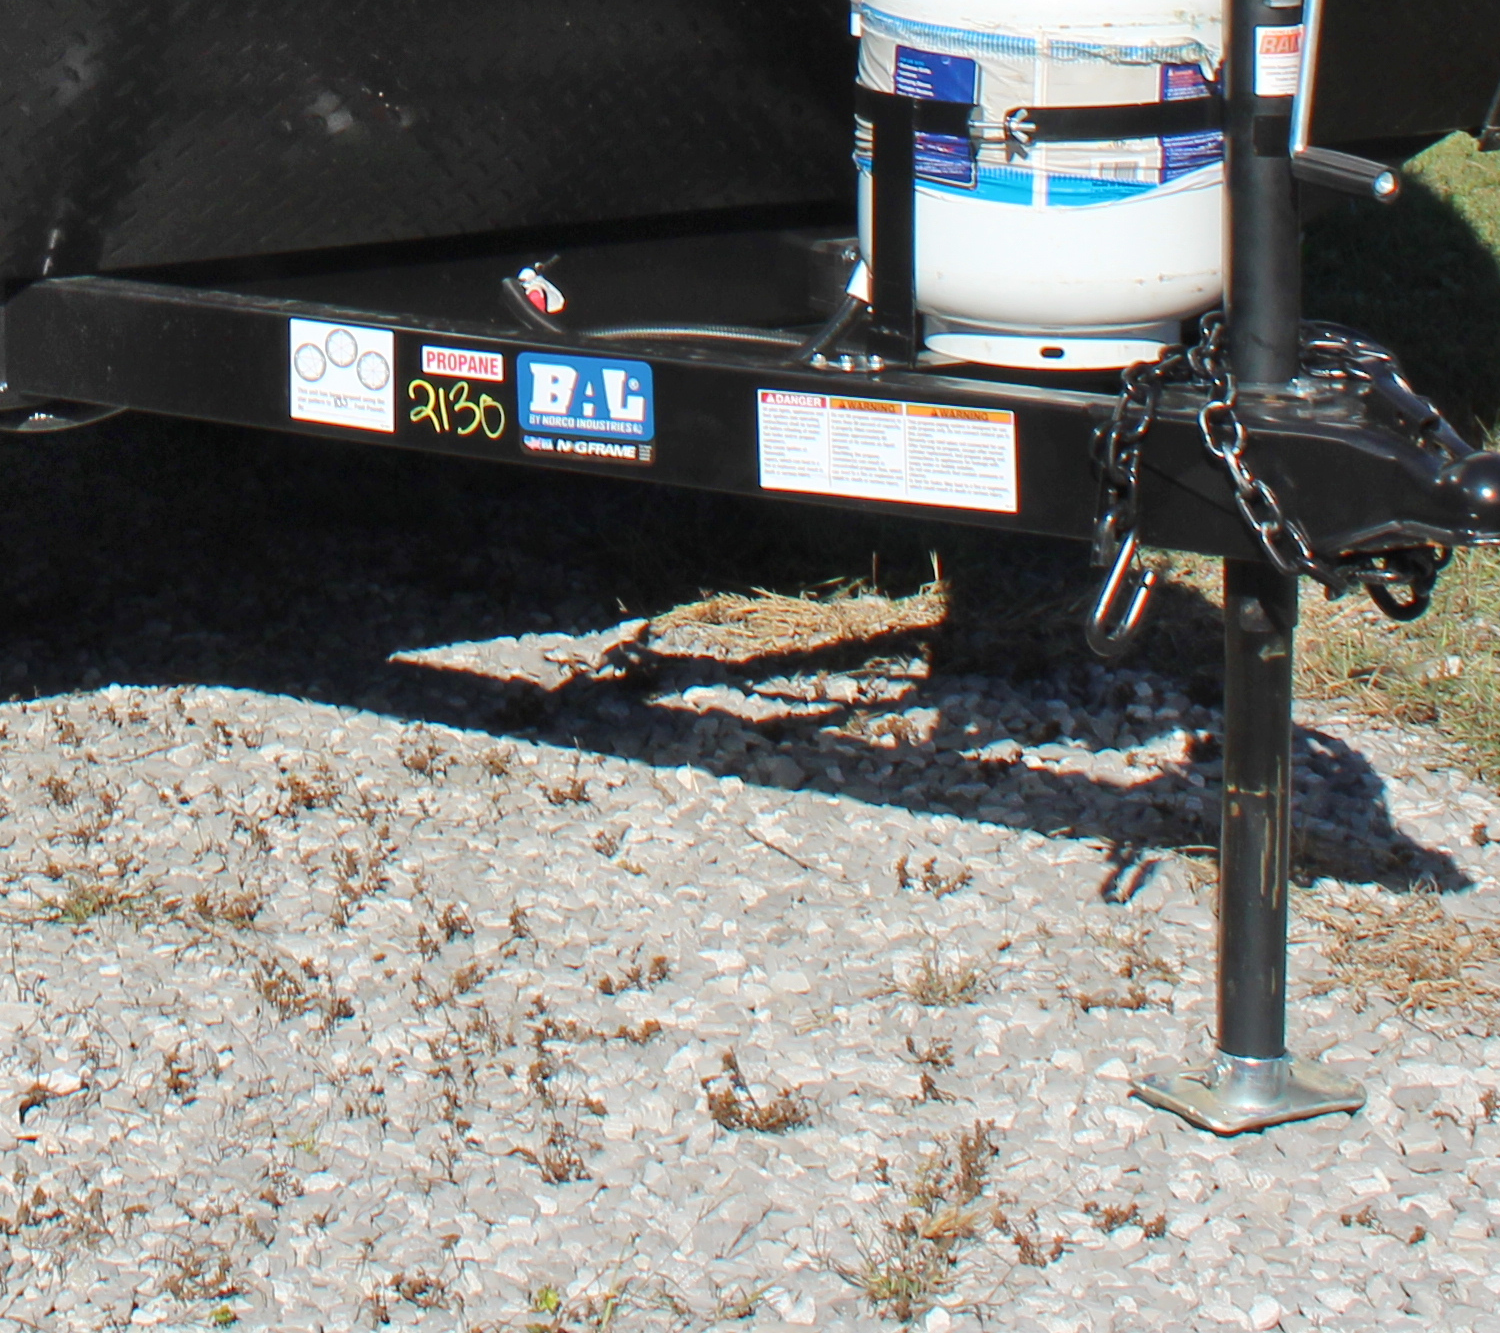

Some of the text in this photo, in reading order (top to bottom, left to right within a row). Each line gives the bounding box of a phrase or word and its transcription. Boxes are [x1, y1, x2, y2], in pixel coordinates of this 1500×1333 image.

[426, 350, 499, 377] PROPANE
[408, 378, 506, 439] 2130
[775, 393, 822, 408] DANGER
[848, 400, 897, 414] WARNING
[940, 409, 990, 423] WARNING
[576, 417, 634, 434] INDUSTRIES
